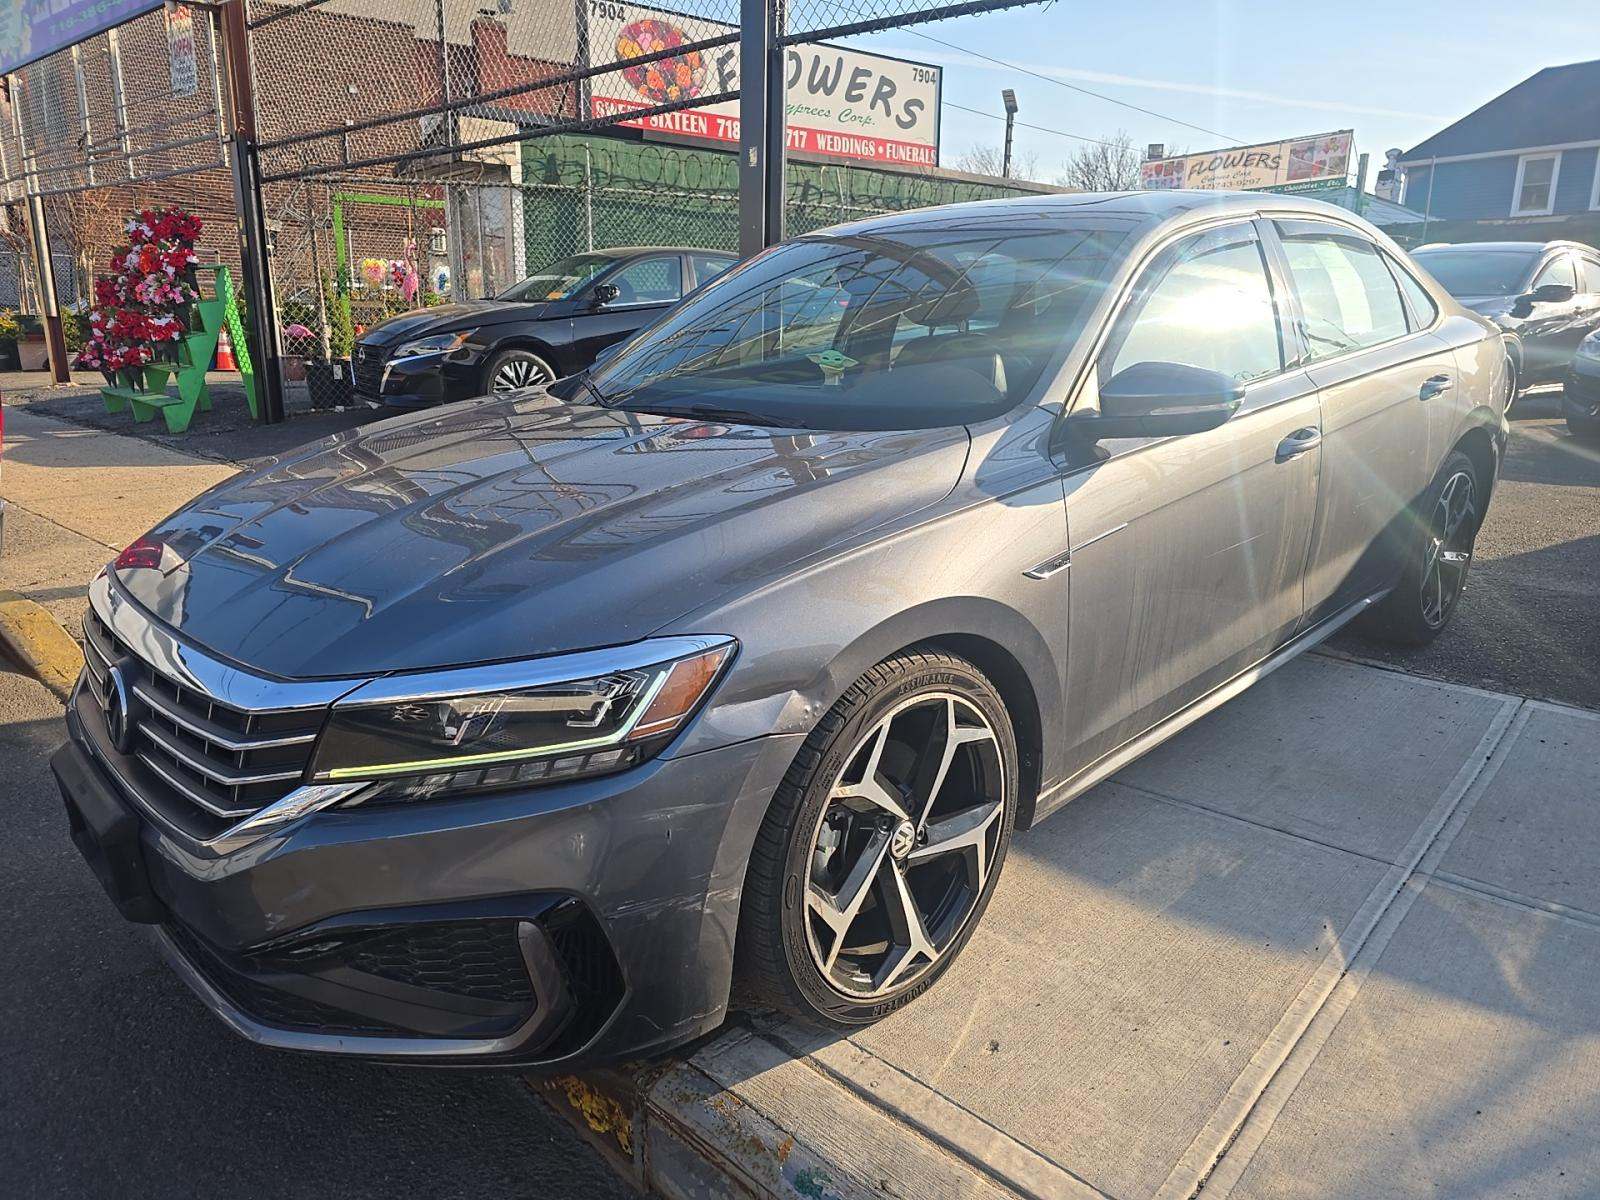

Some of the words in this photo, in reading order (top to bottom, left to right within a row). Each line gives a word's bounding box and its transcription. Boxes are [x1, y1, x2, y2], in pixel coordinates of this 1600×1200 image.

[590, 1, 627, 23] 7904
[912, 67, 936, 86] 7904
[838, 108, 876, 127] Corp.
[649, 111, 708, 135] SIXTEEN
[816, 133, 876, 157] WEDDINGS
[1187, 151, 1282, 180] FLOWERS
[898, 674, 955, 696] ASSURANCE
